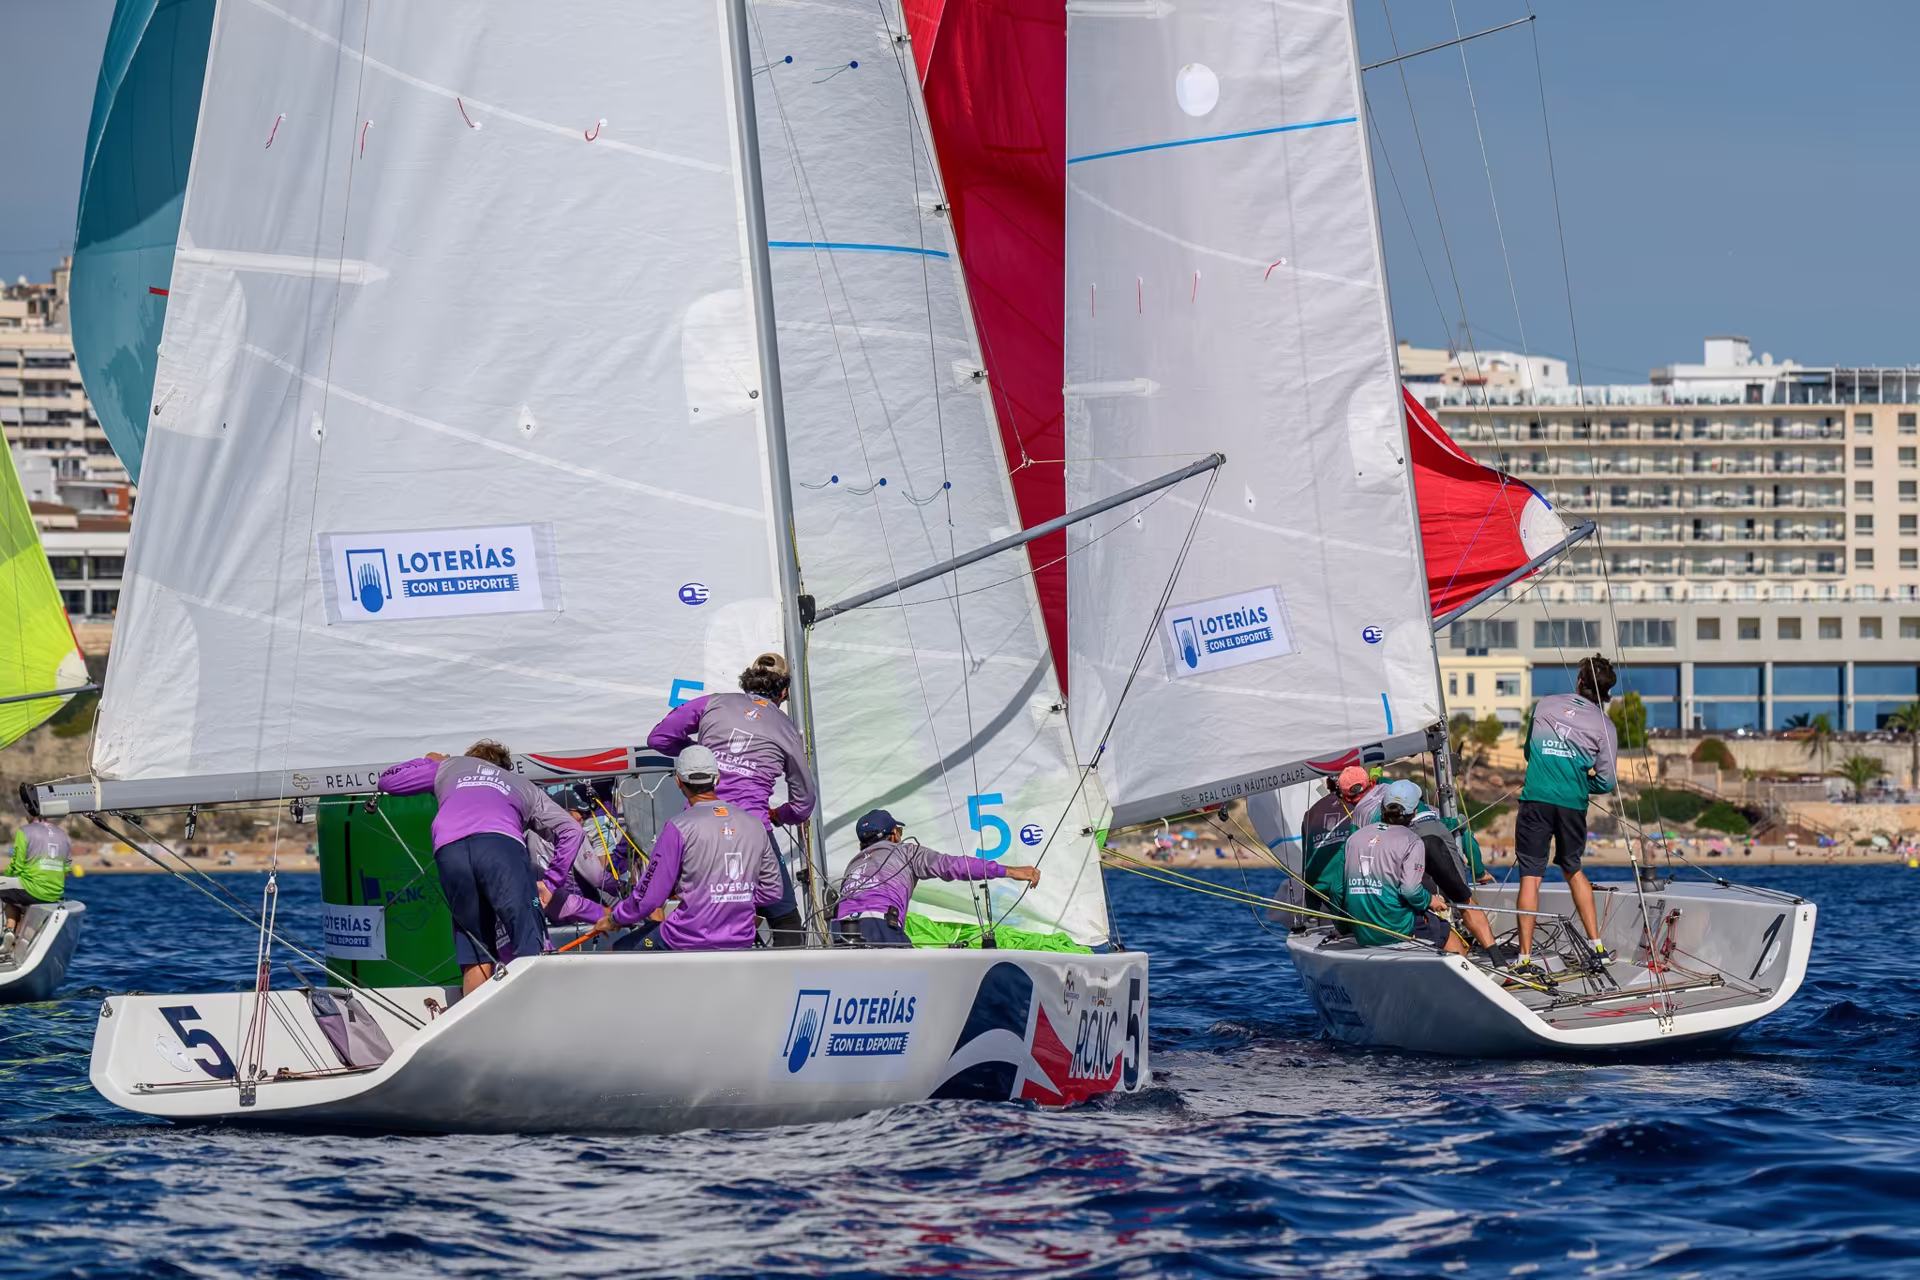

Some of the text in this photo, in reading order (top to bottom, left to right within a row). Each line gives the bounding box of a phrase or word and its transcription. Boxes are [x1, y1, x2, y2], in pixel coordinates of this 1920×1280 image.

[397, 544, 516, 573] LOTERÍAS
[411, 577, 511, 594] CON EL DEPORTE
[1200, 606, 1269, 635] LOTERÍAS
[1209, 630, 1268, 651] CON EL DEPORTE
[325, 773, 363, 789] REAL
[1199, 789, 1219, 804] REAL
[1221, 783, 1242, 799] CLUB
[1244, 773, 1279, 796] NÁUTICO
[1281, 768, 1306, 784] CALPE
[966, 792, 1012, 861] 5
[832, 990, 917, 1025] LOTERÍAS
[158, 1005, 238, 1080] 5
[833, 1036, 903, 1052] CON EL DEPORTE
[1070, 1009, 1118, 1079] RCNC
[1123, 978, 1141, 1092] 5
